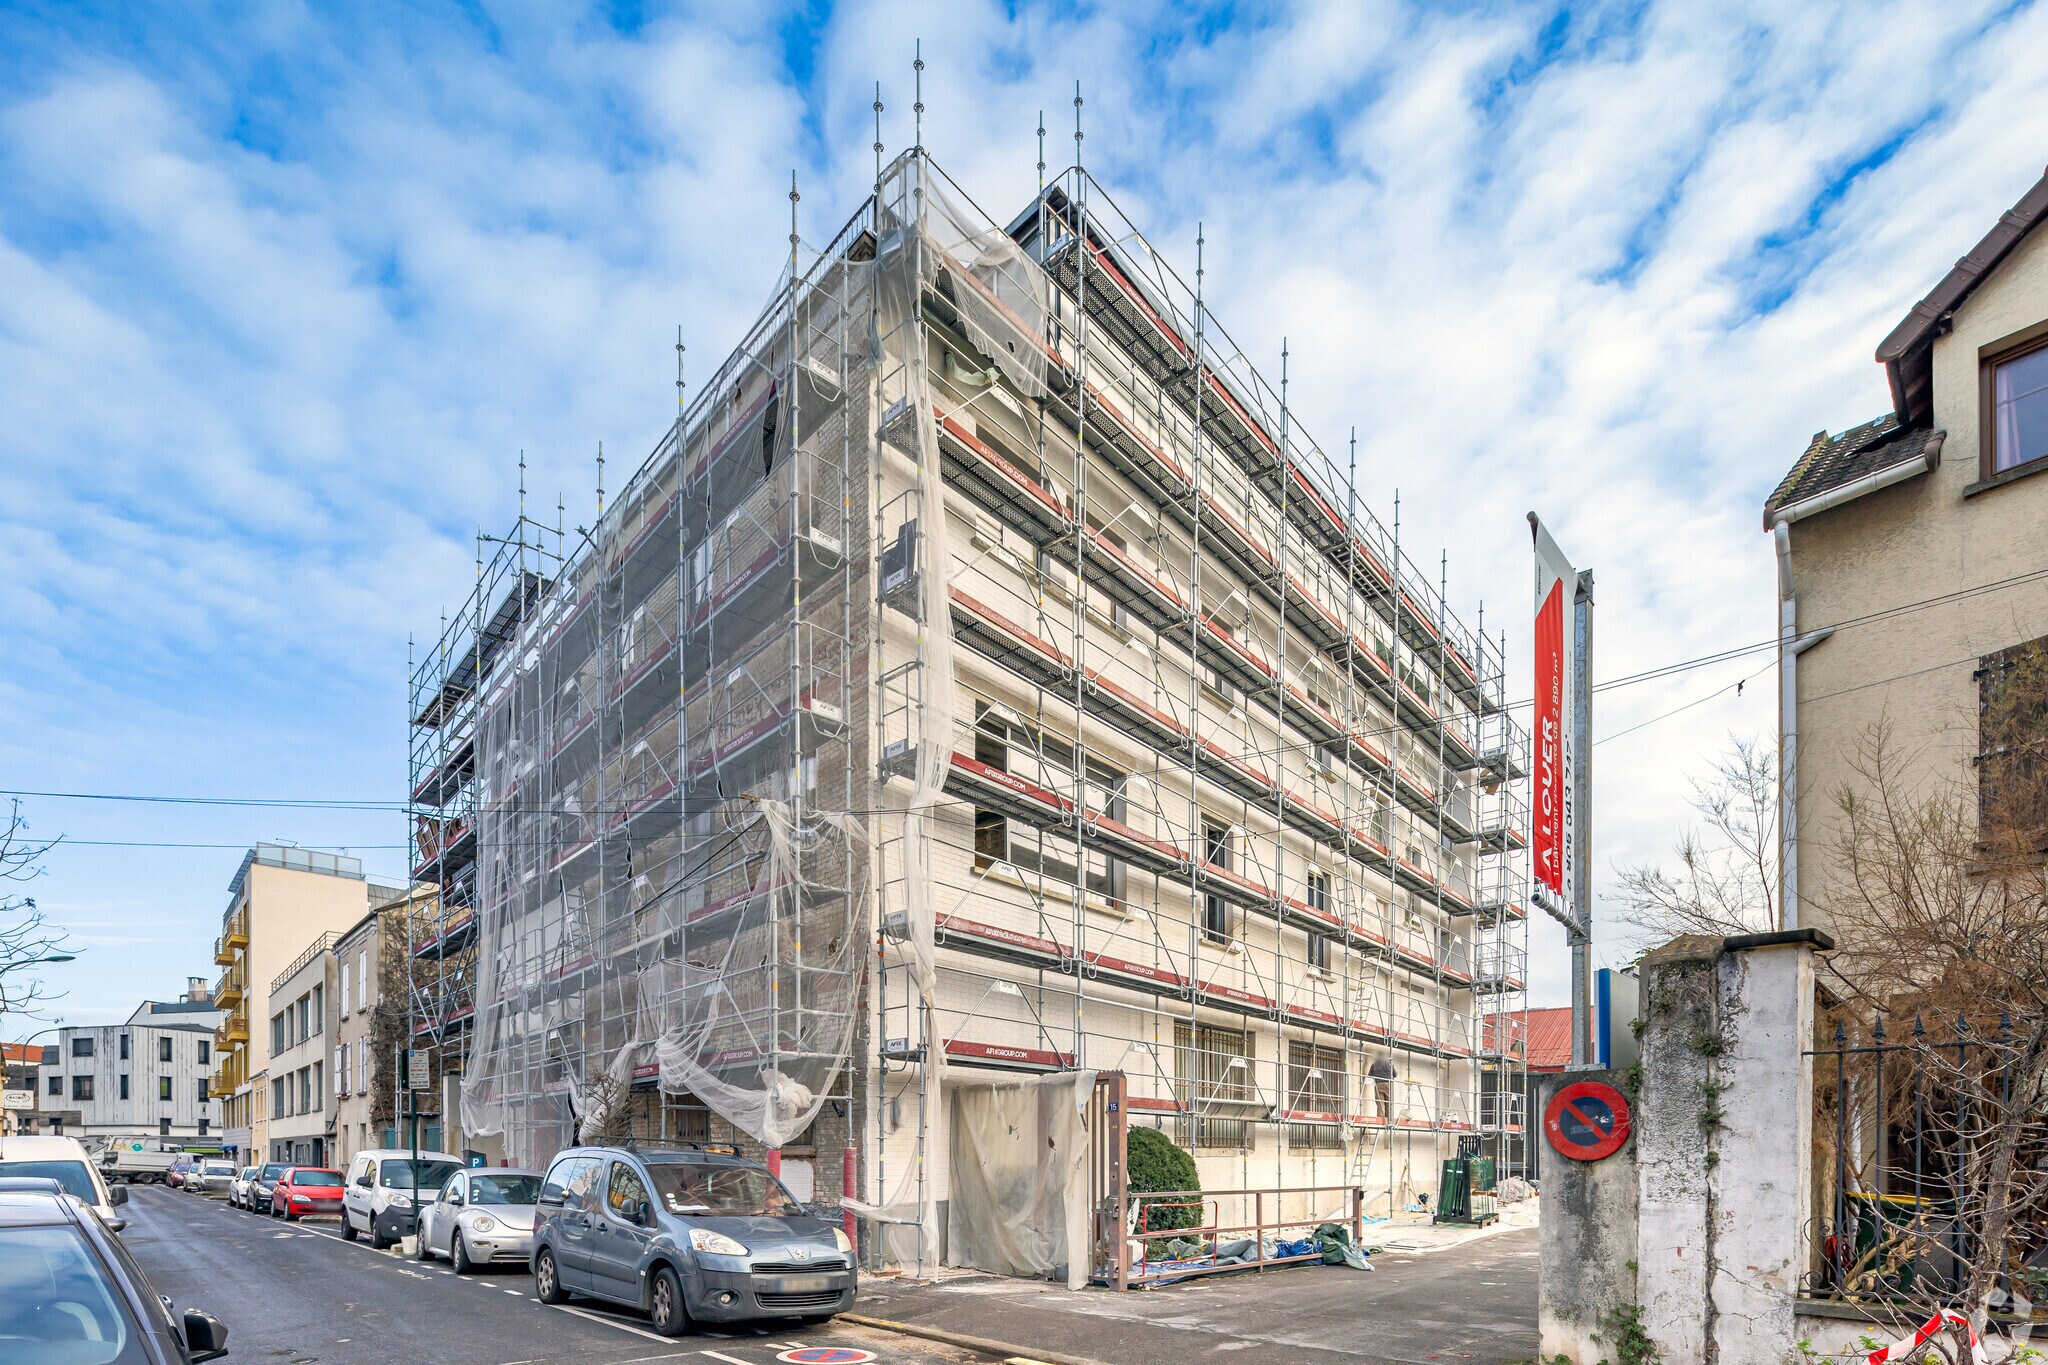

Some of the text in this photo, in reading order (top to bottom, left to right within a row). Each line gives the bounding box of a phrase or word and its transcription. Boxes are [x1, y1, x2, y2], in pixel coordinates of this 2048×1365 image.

[888, 404, 900, 415] AFIX
[980, 446, 1028, 486] AFIXGROUP.COM
[889, 573, 901, 583] AFIX
[1552, 651, 1558, 673] m²
[1552, 708, 1558, 718] 2
[1553, 721, 1558, 740] de
[890, 744, 902, 752] AFIX
[984, 767, 1026, 790] AFIXGROUP.COM
[1542, 715, 1553, 836] LOUER
[986, 1048, 1028, 1059] AFIXGROUP.COM
[1109, 1103, 1117, 1111] 15
[472, 1158, 480, 1167] P
